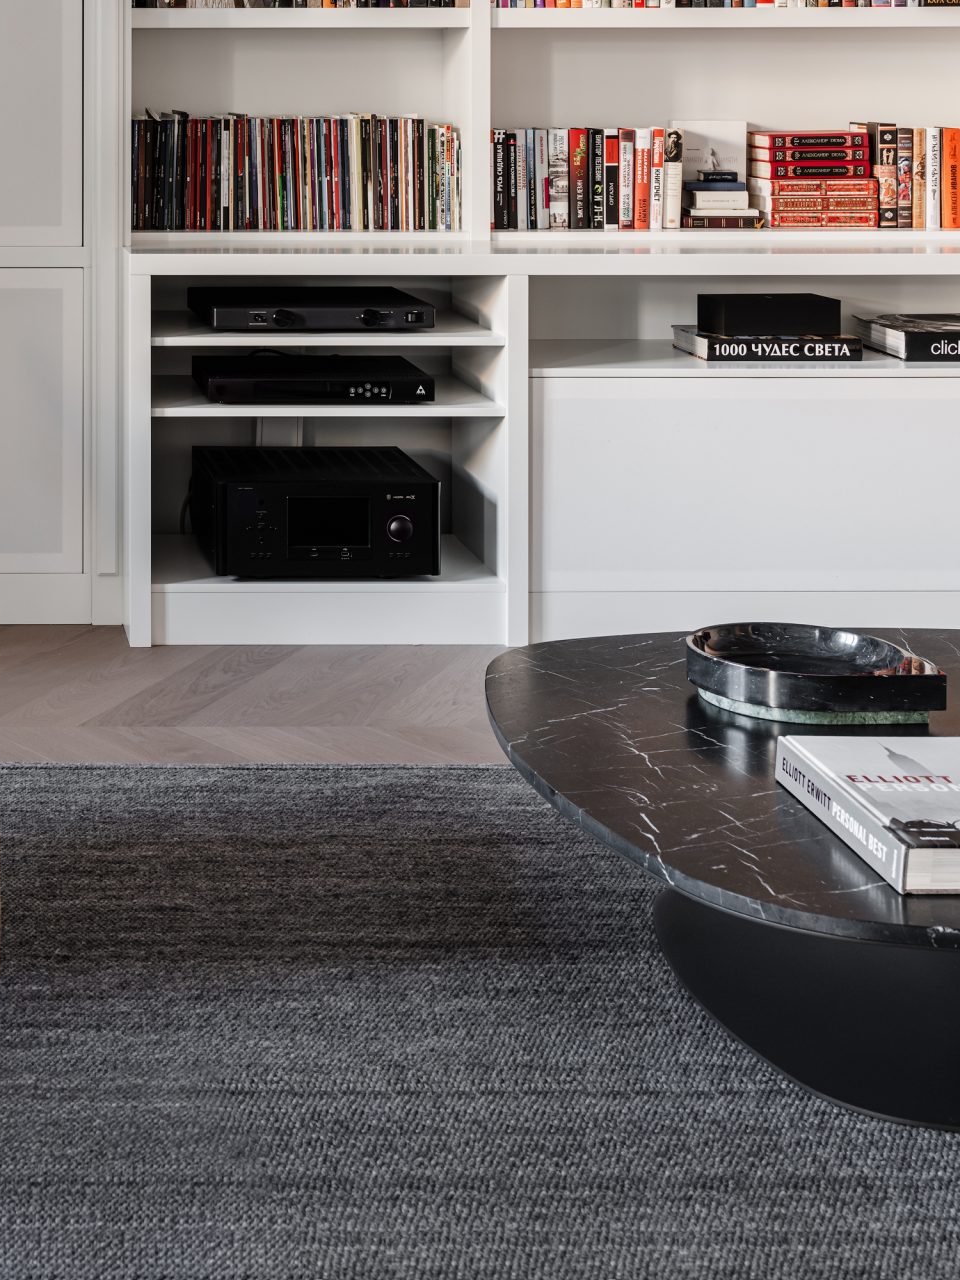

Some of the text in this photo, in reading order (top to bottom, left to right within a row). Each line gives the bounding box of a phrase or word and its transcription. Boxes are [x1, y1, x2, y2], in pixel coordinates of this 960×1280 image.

[496, 144, 504, 175] СИДЯЩАЯ
[576, 179, 584, 201] ПЕЛЕВИН
[653, 168, 662, 202] КНИГОЧЁТ
[713, 343, 851, 357] 1000 ЧУДЕС СВЕТА
[846, 775, 953, 784] ELLIOTT
[782, 756, 806, 789] ELLIOTT
[806, 779, 832, 811] ERWITT
[831, 800, 868, 848] PERSONAL
[867, 833, 888, 863] BEST
